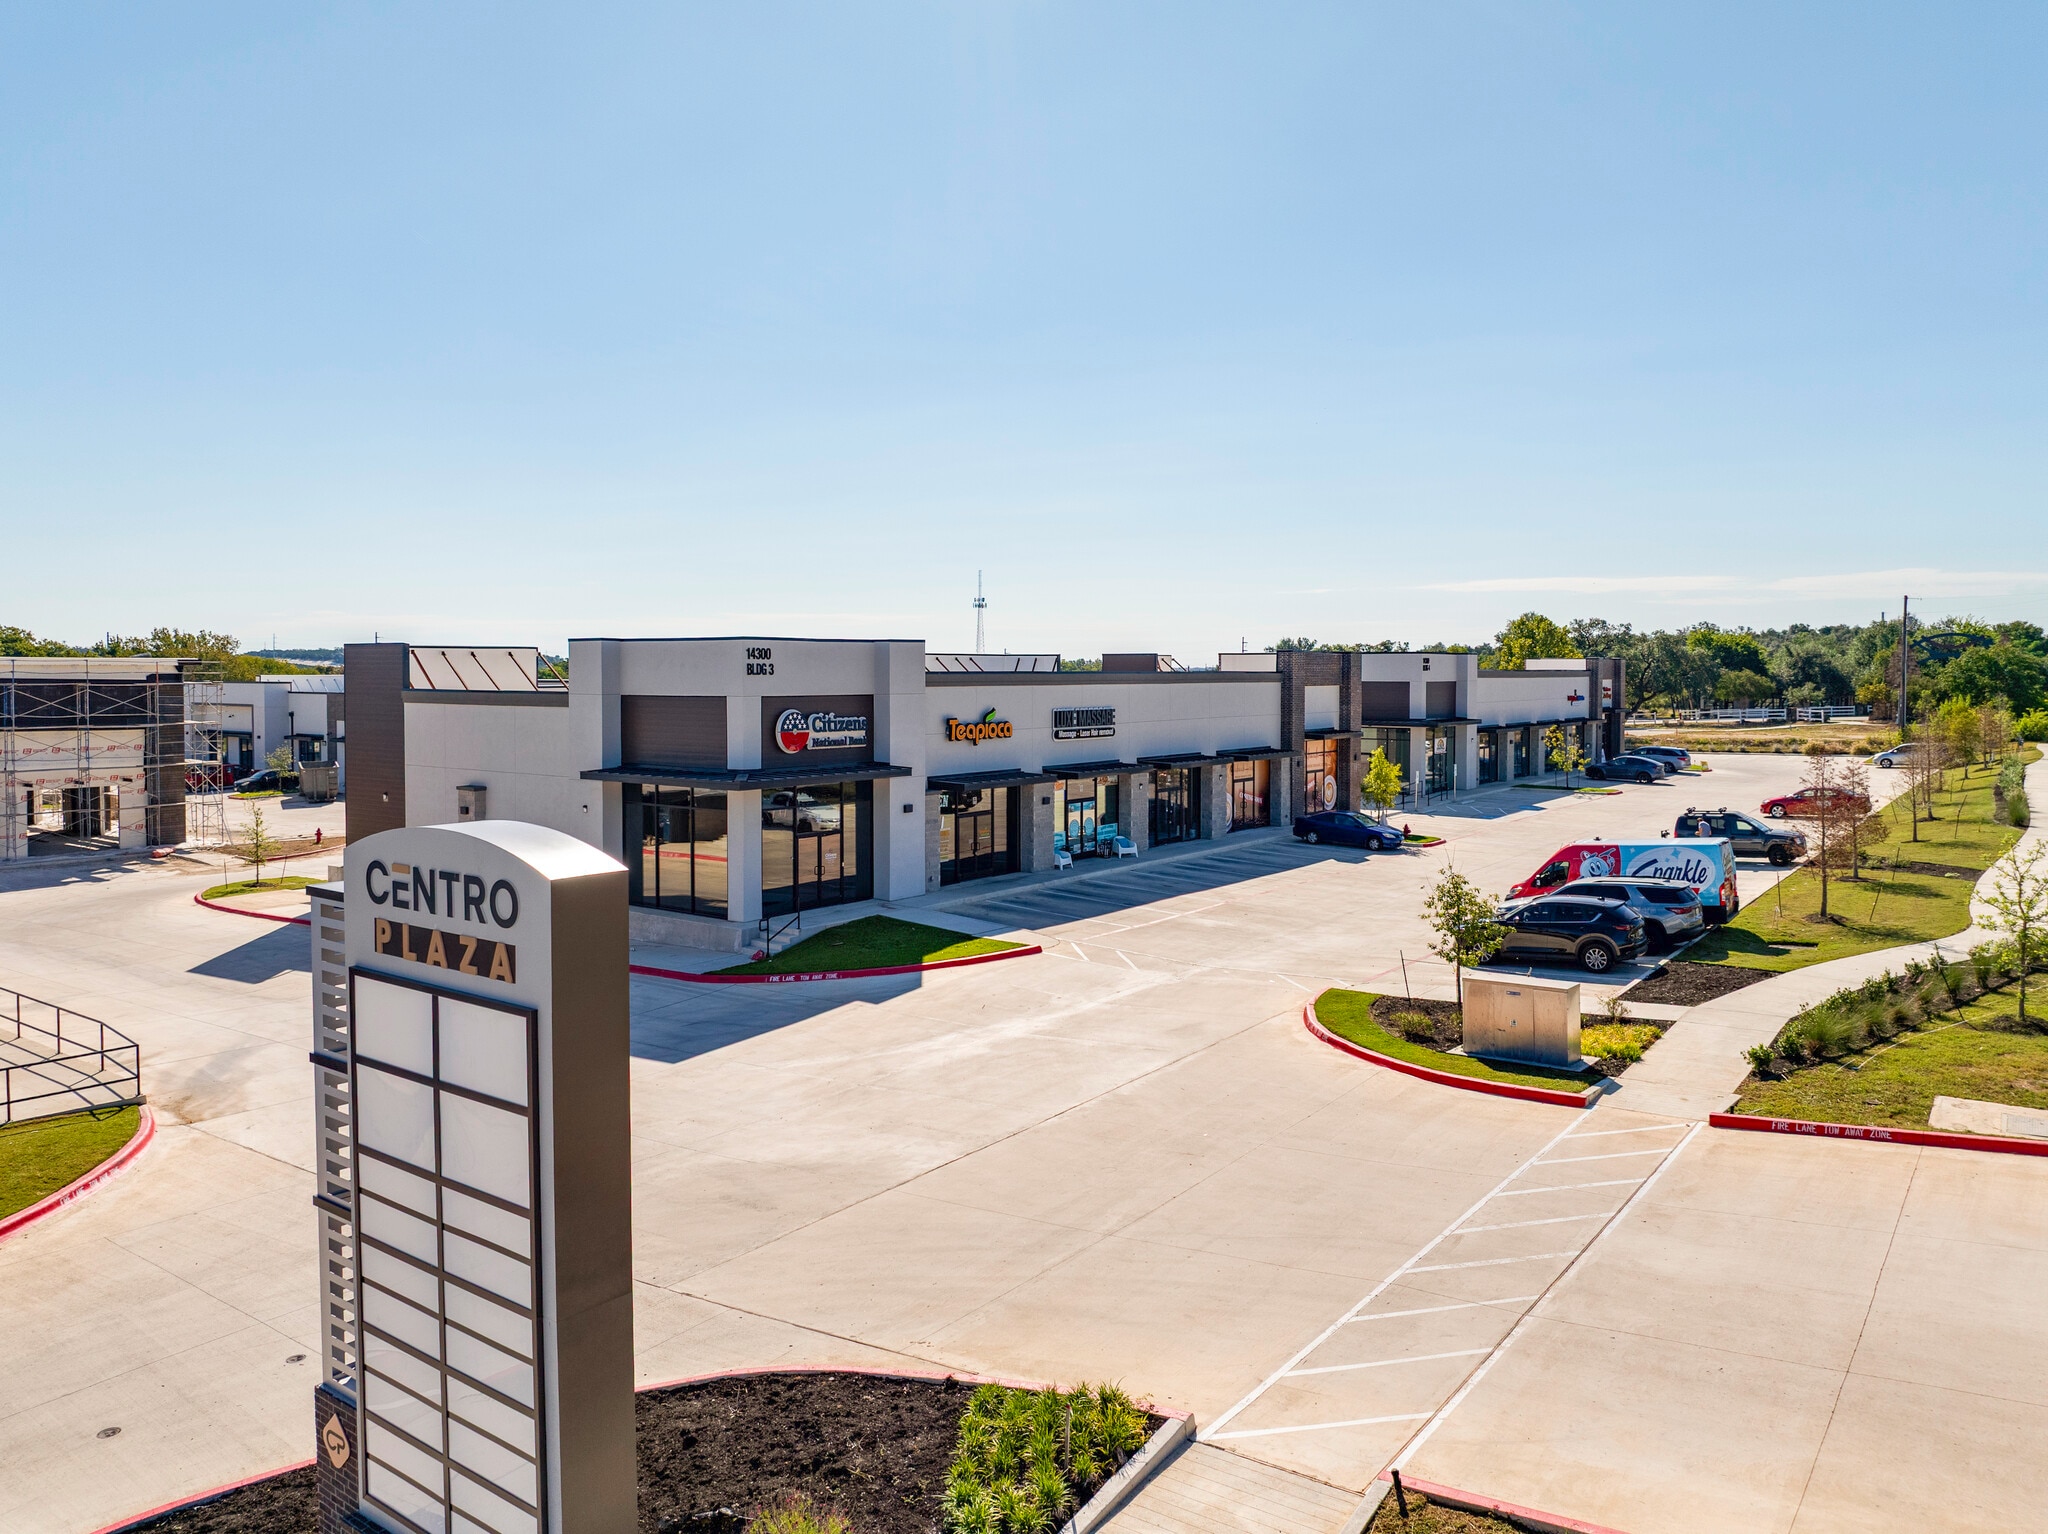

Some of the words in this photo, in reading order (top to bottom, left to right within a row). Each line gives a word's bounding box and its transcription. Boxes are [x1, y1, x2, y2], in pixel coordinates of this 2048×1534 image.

[745, 647, 772, 660] 14300
[746, 663, 768, 676] BLDG
[768, 663, 775, 676] 3
[812, 714, 868, 732] Citizens
[1077, 709, 1116, 727] MASSAGE
[947, 716, 1013, 746] Teapioca
[811, 736, 848, 747] National
[366, 860, 519, 929] CENTRO
[376, 917, 513, 984] PLAZA
[1771, 1120, 1791, 1131] FIRE
[1795, 1123, 1818, 1134] LANE
[1823, 1125, 1840, 1135] TOW
[1844, 1127, 1865, 1137] AWAY
[1869, 1129, 1892, 1139] ZONE
